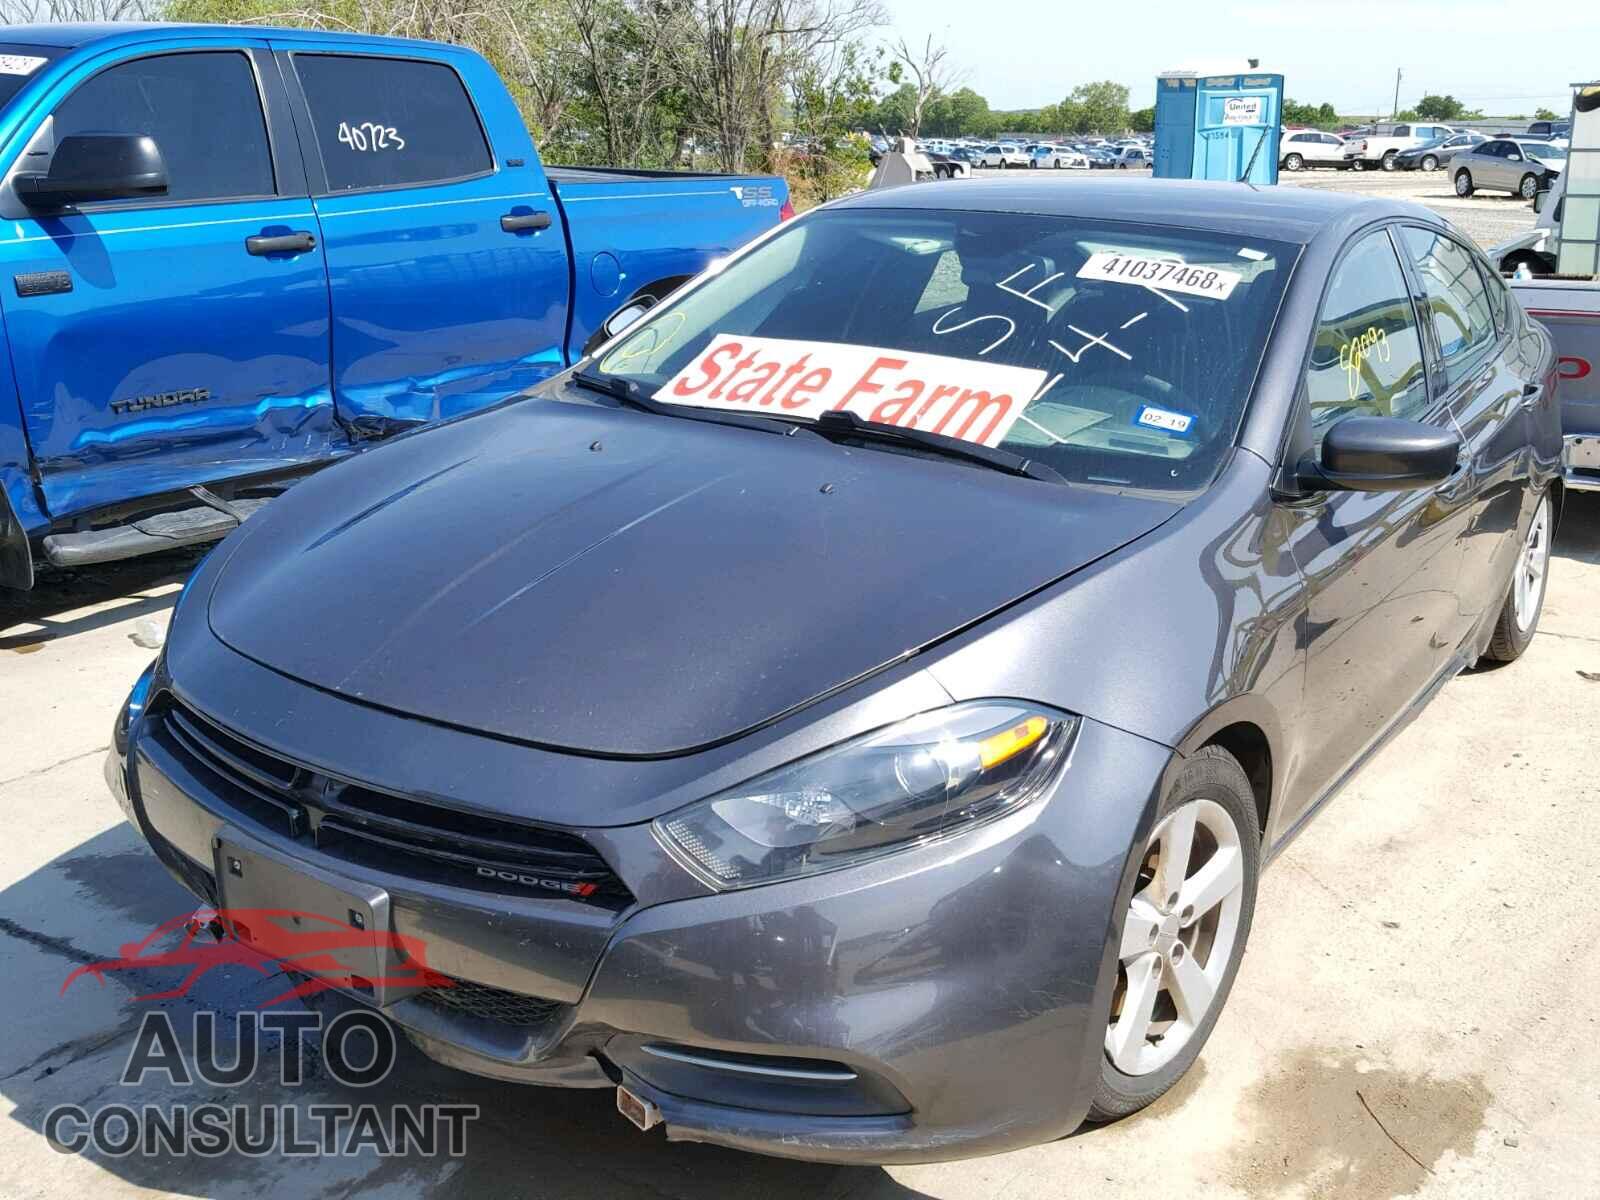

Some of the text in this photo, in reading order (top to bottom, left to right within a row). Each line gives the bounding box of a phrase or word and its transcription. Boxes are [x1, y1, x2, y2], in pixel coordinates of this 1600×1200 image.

[337, 121, 405, 152] 40723
[1101, 256, 1218, 290] 41037468
[110, 387, 210, 414] TUNDRA
[673, 342, 832, 410] State
[834, 357, 1014, 447] Farm
[476, 866, 580, 892] DODGE
